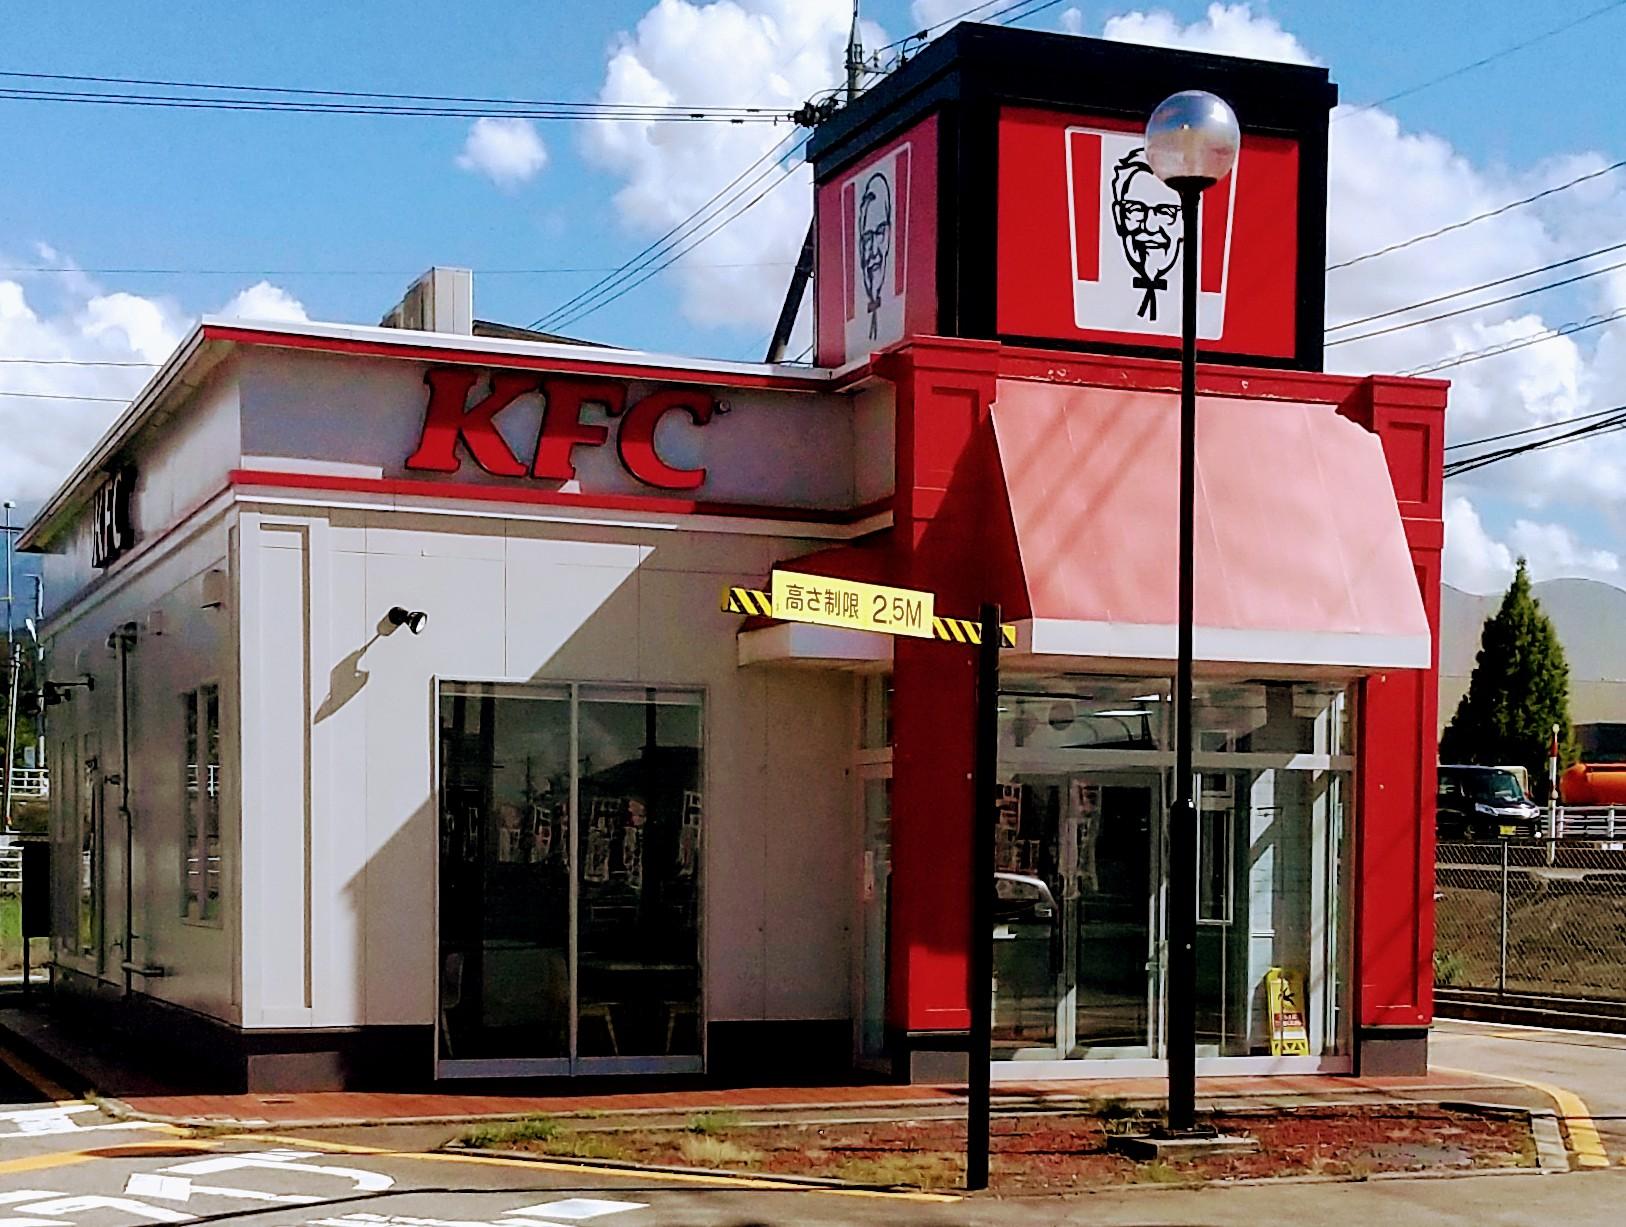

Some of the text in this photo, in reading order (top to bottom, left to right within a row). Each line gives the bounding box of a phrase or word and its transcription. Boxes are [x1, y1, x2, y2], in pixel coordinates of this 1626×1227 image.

[405, 367, 717, 491] KFC
[785, 583, 922, 629] 高さ制限 2.5M
